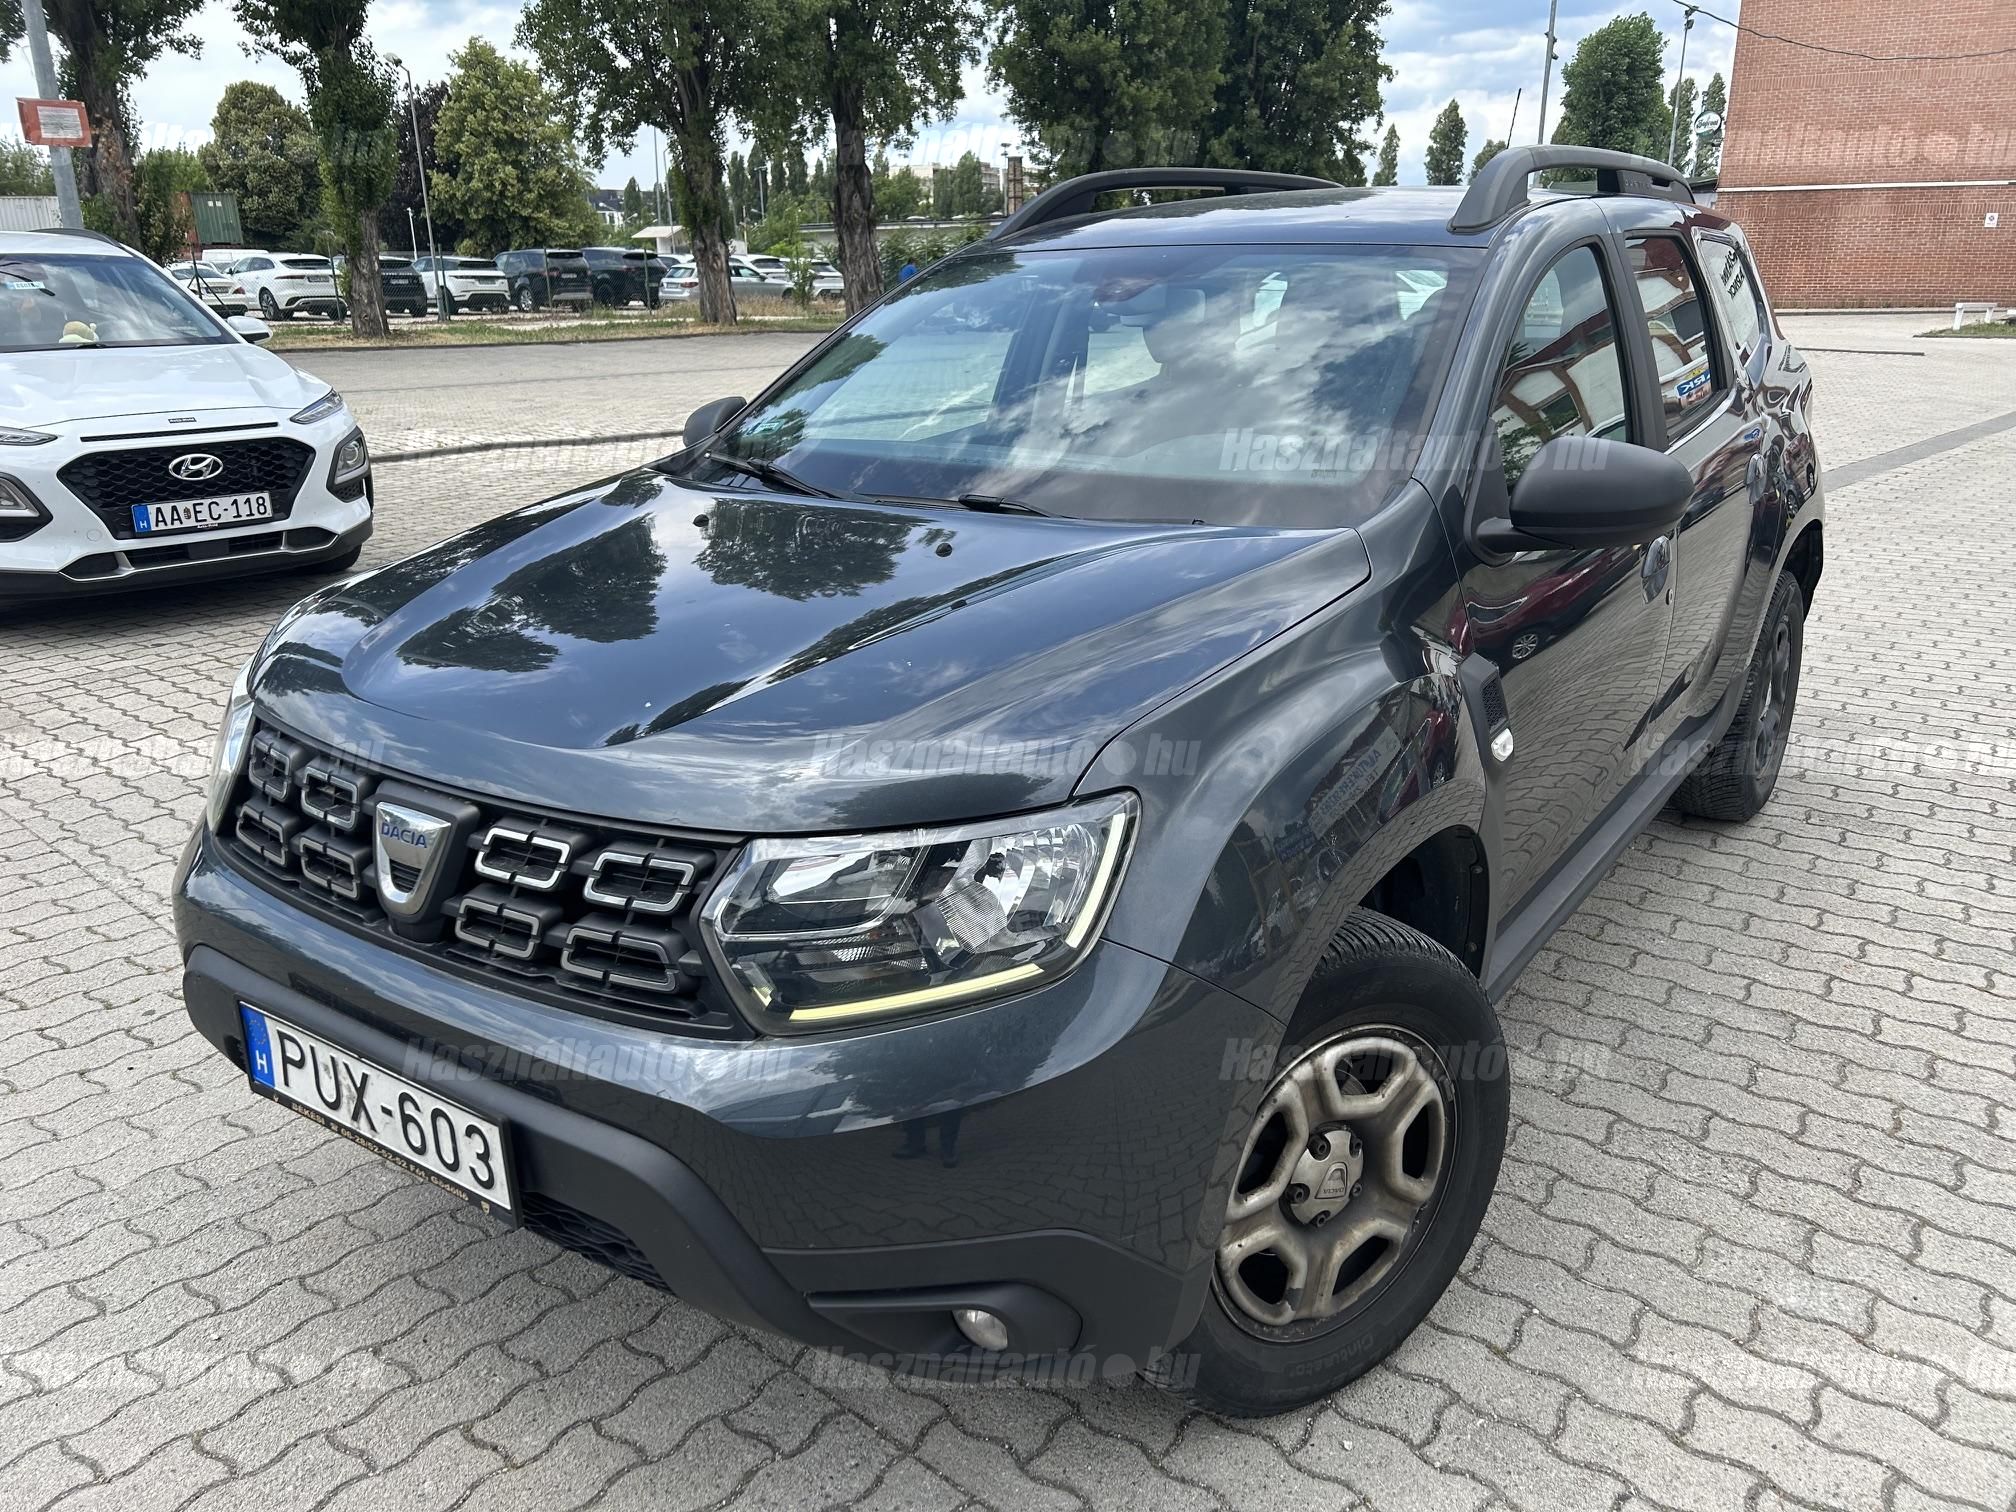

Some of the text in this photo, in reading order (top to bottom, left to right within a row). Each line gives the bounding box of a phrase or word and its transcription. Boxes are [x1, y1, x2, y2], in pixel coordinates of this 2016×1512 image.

[381, 822, 428, 848] DACIA
[255, 1050, 268, 1074] H
[276, 1027, 495, 1190] PUX-603
